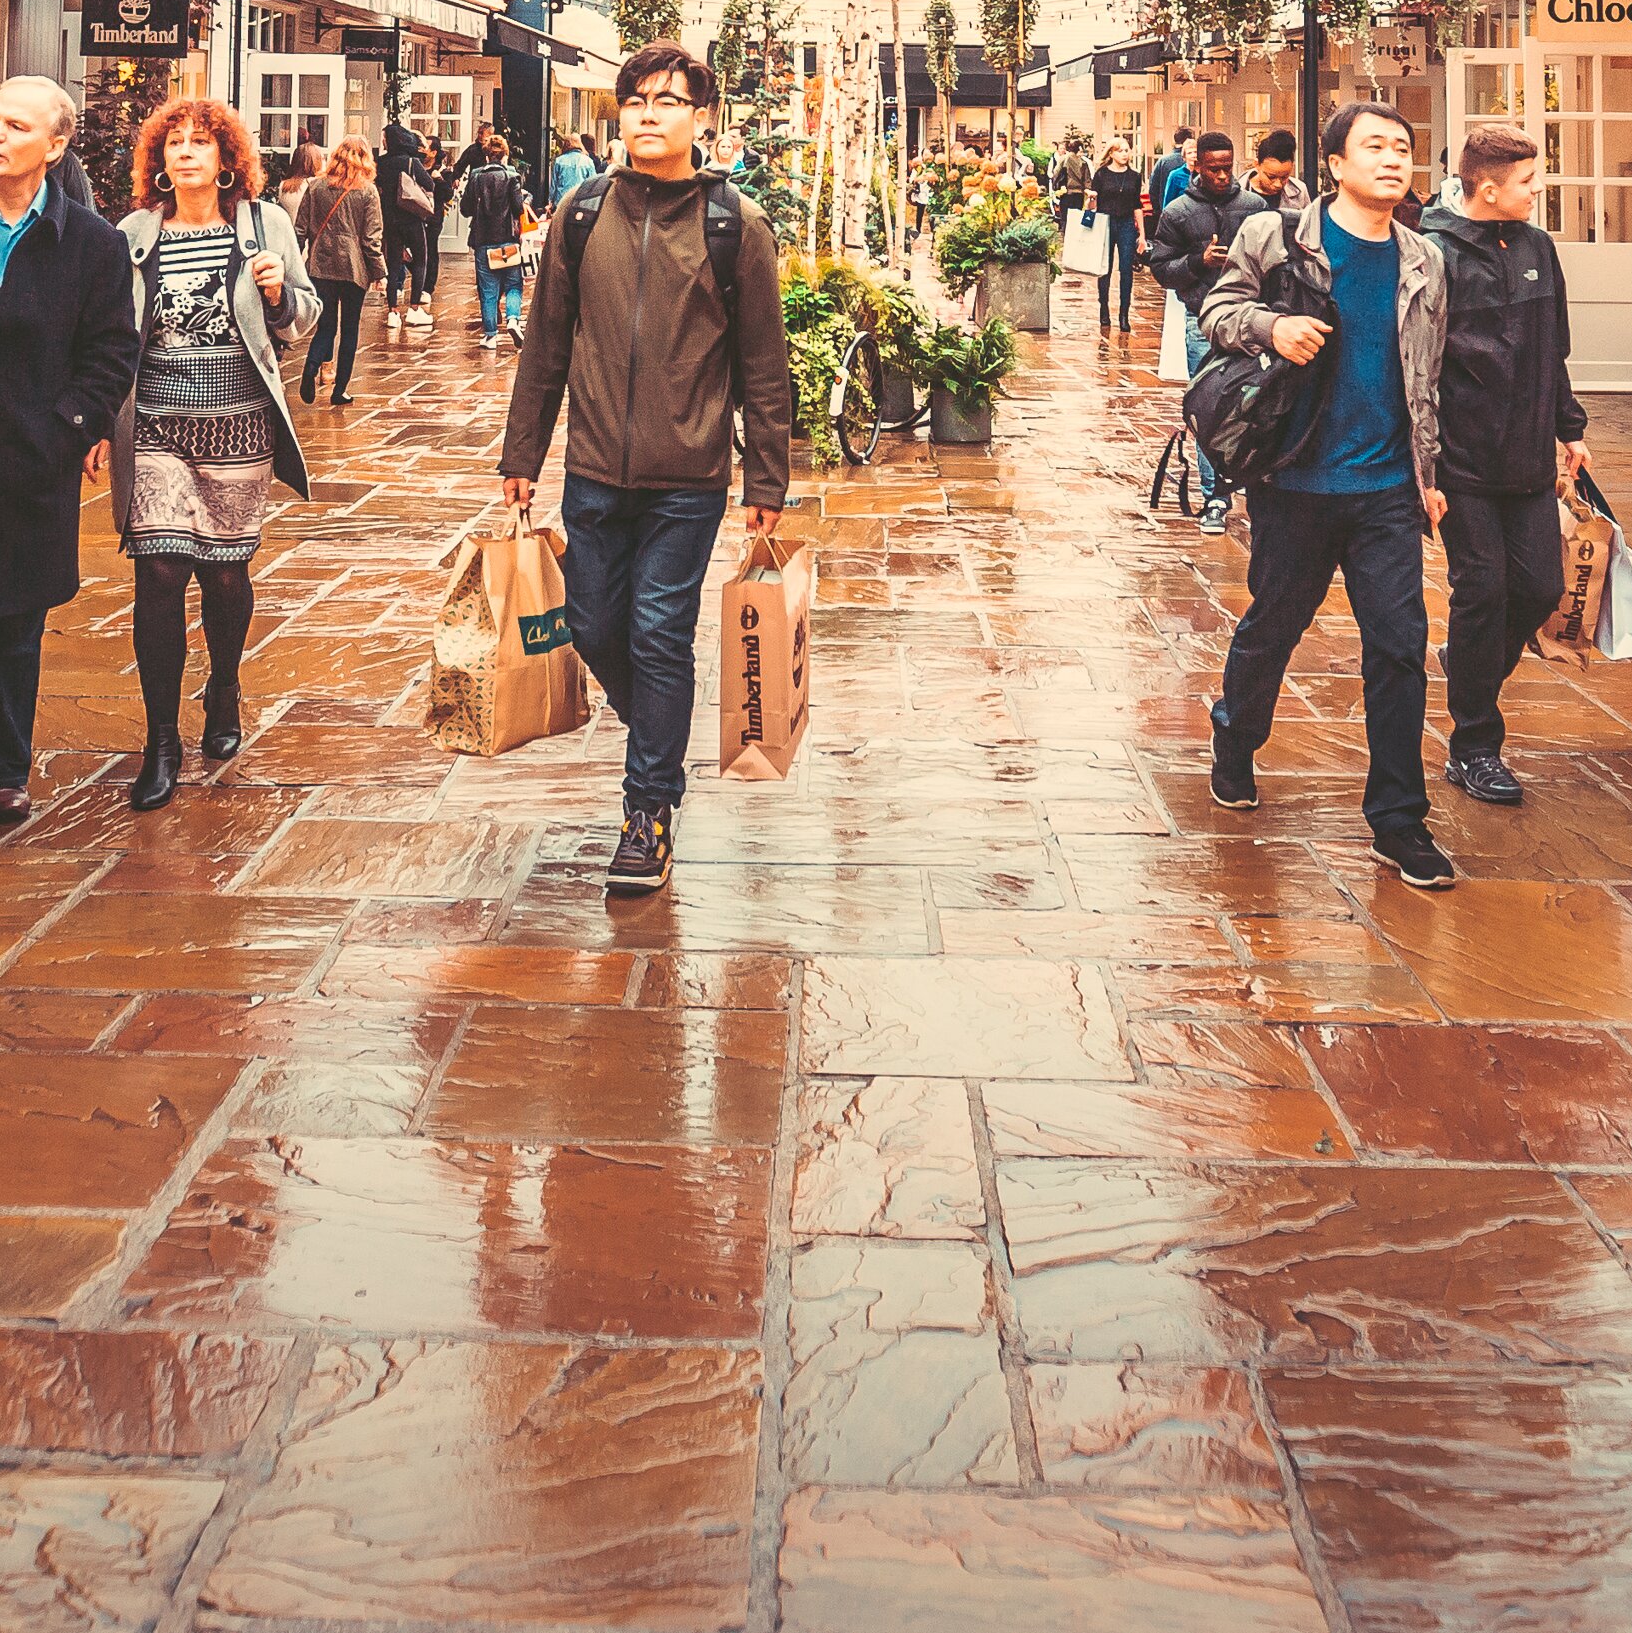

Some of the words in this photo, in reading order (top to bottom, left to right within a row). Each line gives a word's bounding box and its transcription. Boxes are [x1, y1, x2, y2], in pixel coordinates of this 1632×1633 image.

[90, 23, 178, 43] Timberland
[1555, 565, 1593, 642] Timberland
[741, 635, 763, 746] Timberland
